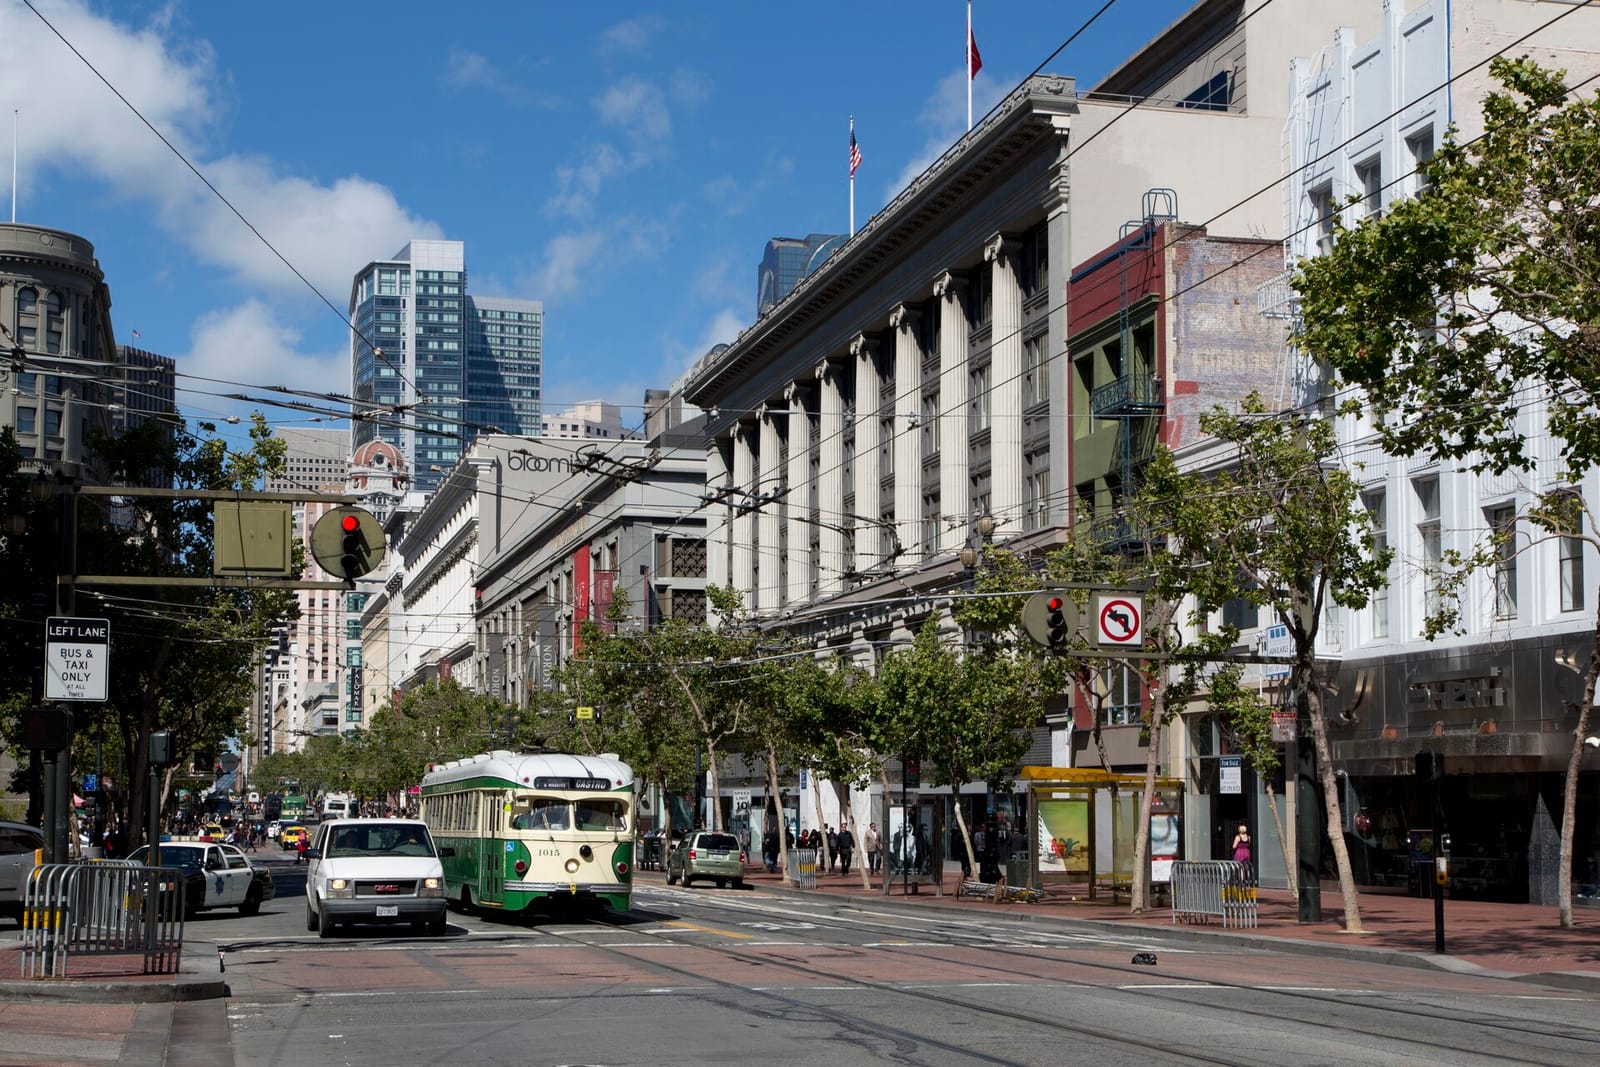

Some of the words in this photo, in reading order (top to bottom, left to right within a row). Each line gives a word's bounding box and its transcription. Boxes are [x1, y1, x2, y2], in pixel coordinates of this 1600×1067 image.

[508, 451, 582, 473] bloomi
[49, 626, 75, 636] LEFT
[78, 627, 107, 638] LANE
[60, 648, 82, 658] BUS
[85, 649, 94, 658] &
[65, 660, 88, 670] TAXI
[543, 645, 553, 690] NORDST
[61, 672, 91, 682] ONLY
[737, 801, 748, 810] 10
